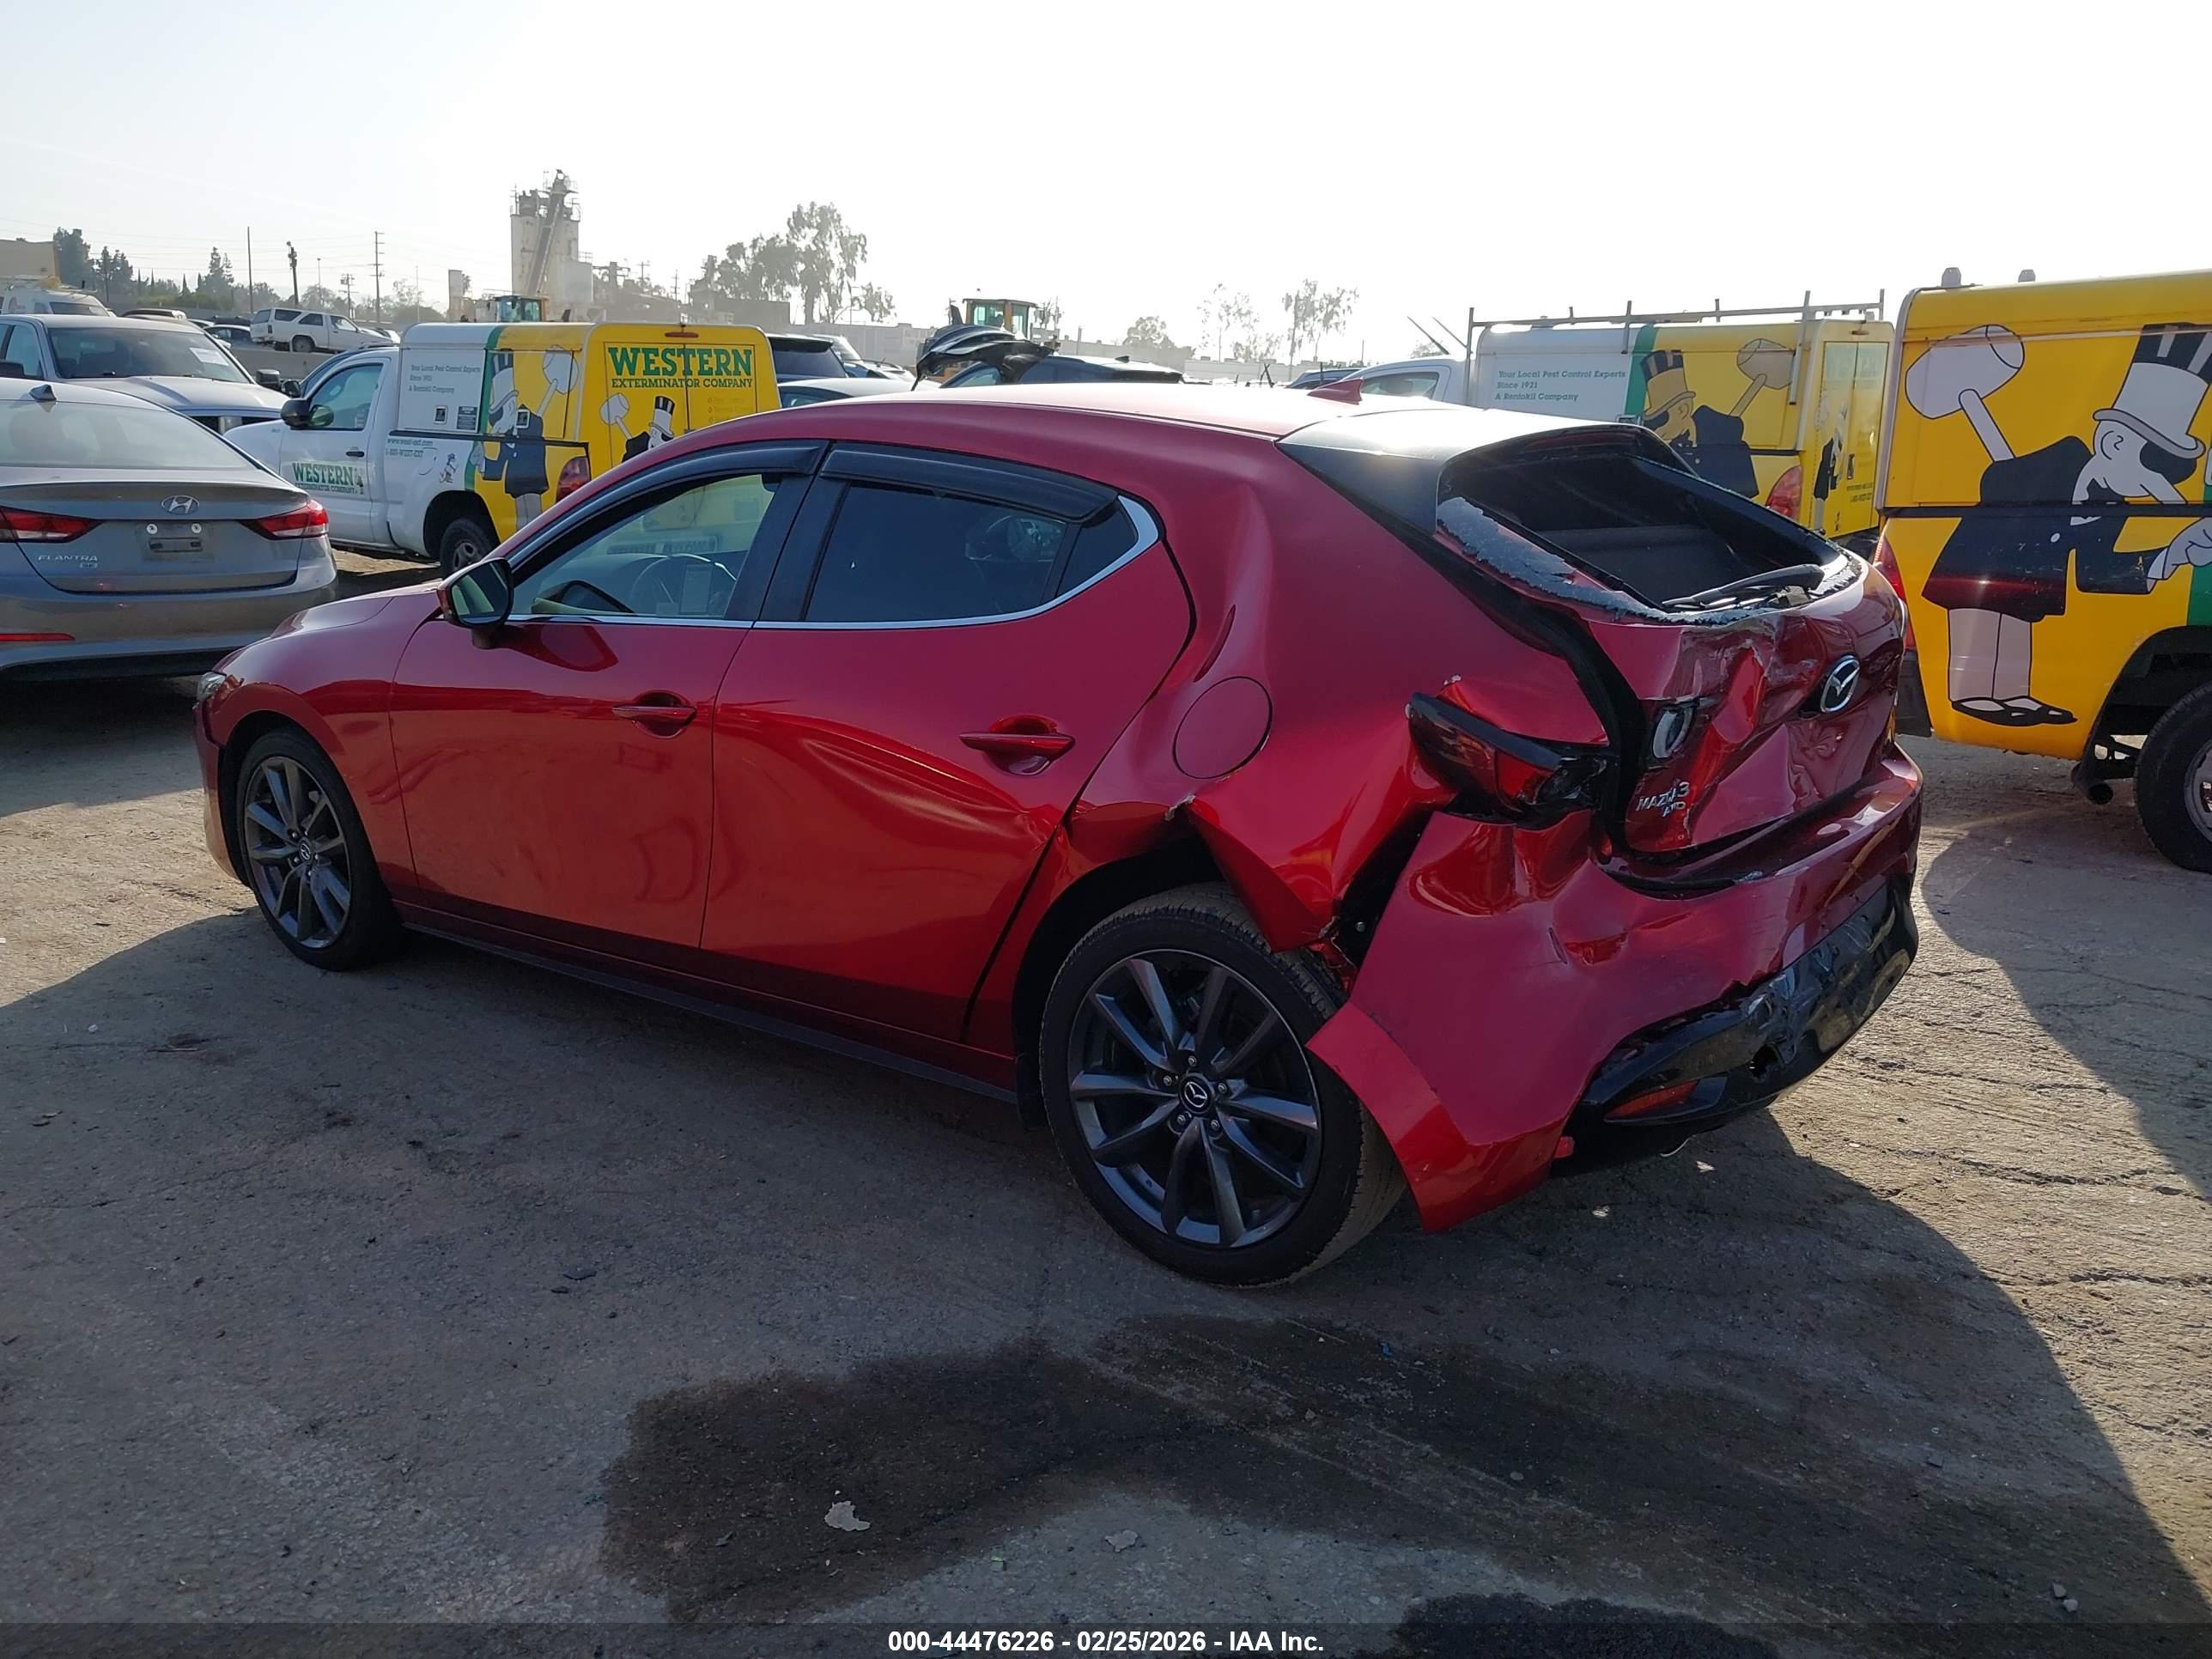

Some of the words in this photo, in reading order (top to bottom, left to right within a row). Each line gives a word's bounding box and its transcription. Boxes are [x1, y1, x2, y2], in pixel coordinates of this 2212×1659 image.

[608, 347, 753, 376] WESTERN
[1498, 370, 1516, 379] Your
[1517, 370, 1540, 379] Local
[1542, 370, 1559, 379] Pest
[1561, 370, 1591, 379] Control
[1593, 370, 1626, 380] Experts
[611, 378, 700, 388] EXTERMINATOR
[703, 378, 753, 388] COMPANY
[1538, 392, 1579, 402] Company
[293, 463, 354, 486] WESTERN
